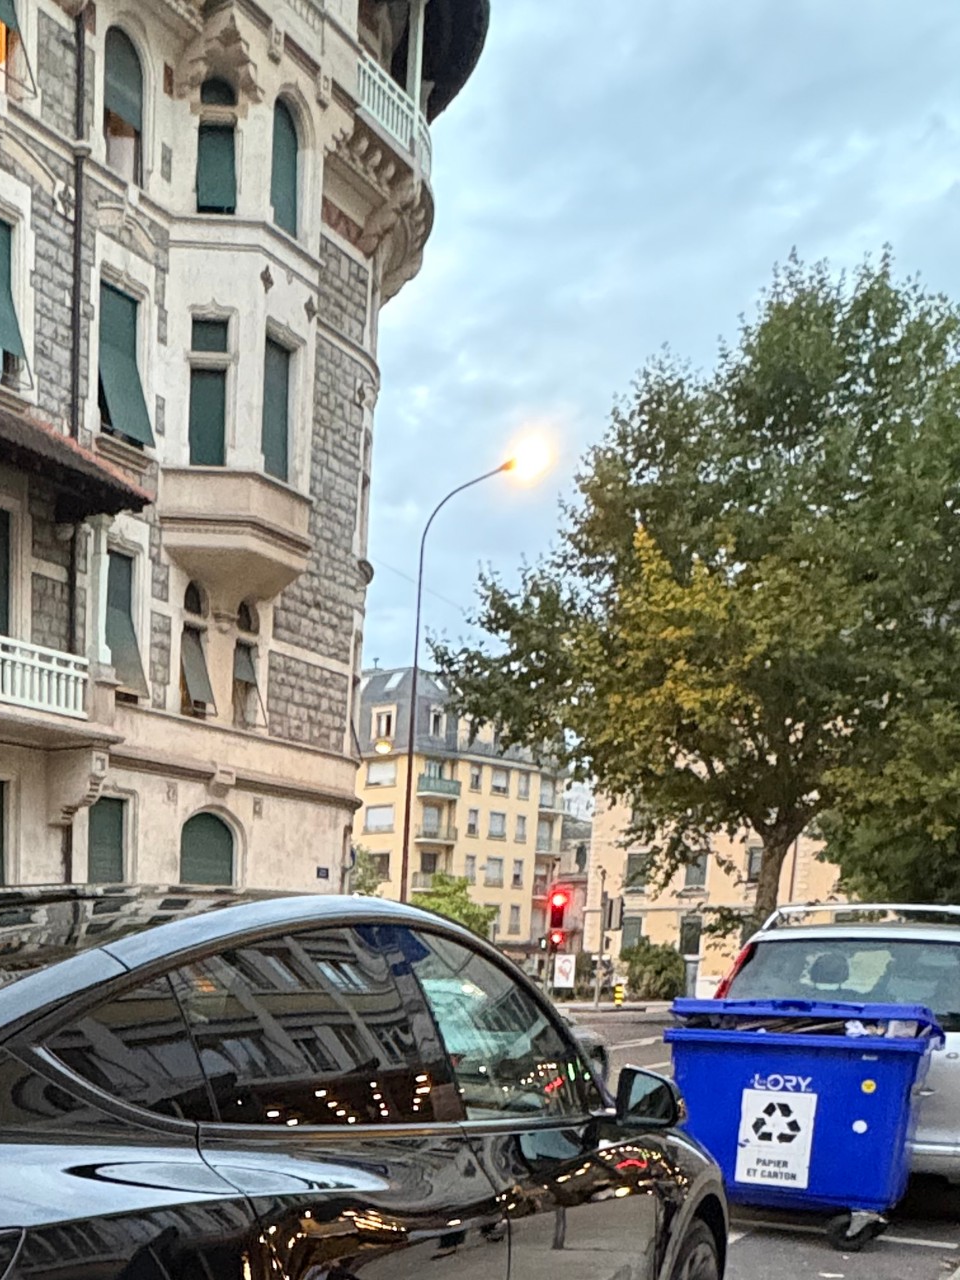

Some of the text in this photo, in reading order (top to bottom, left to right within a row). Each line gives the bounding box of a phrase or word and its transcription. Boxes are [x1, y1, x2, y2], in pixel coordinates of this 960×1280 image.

[756, 1157, 789, 1169] PAPIER
[746, 1168, 797, 1181] ET CARTON
